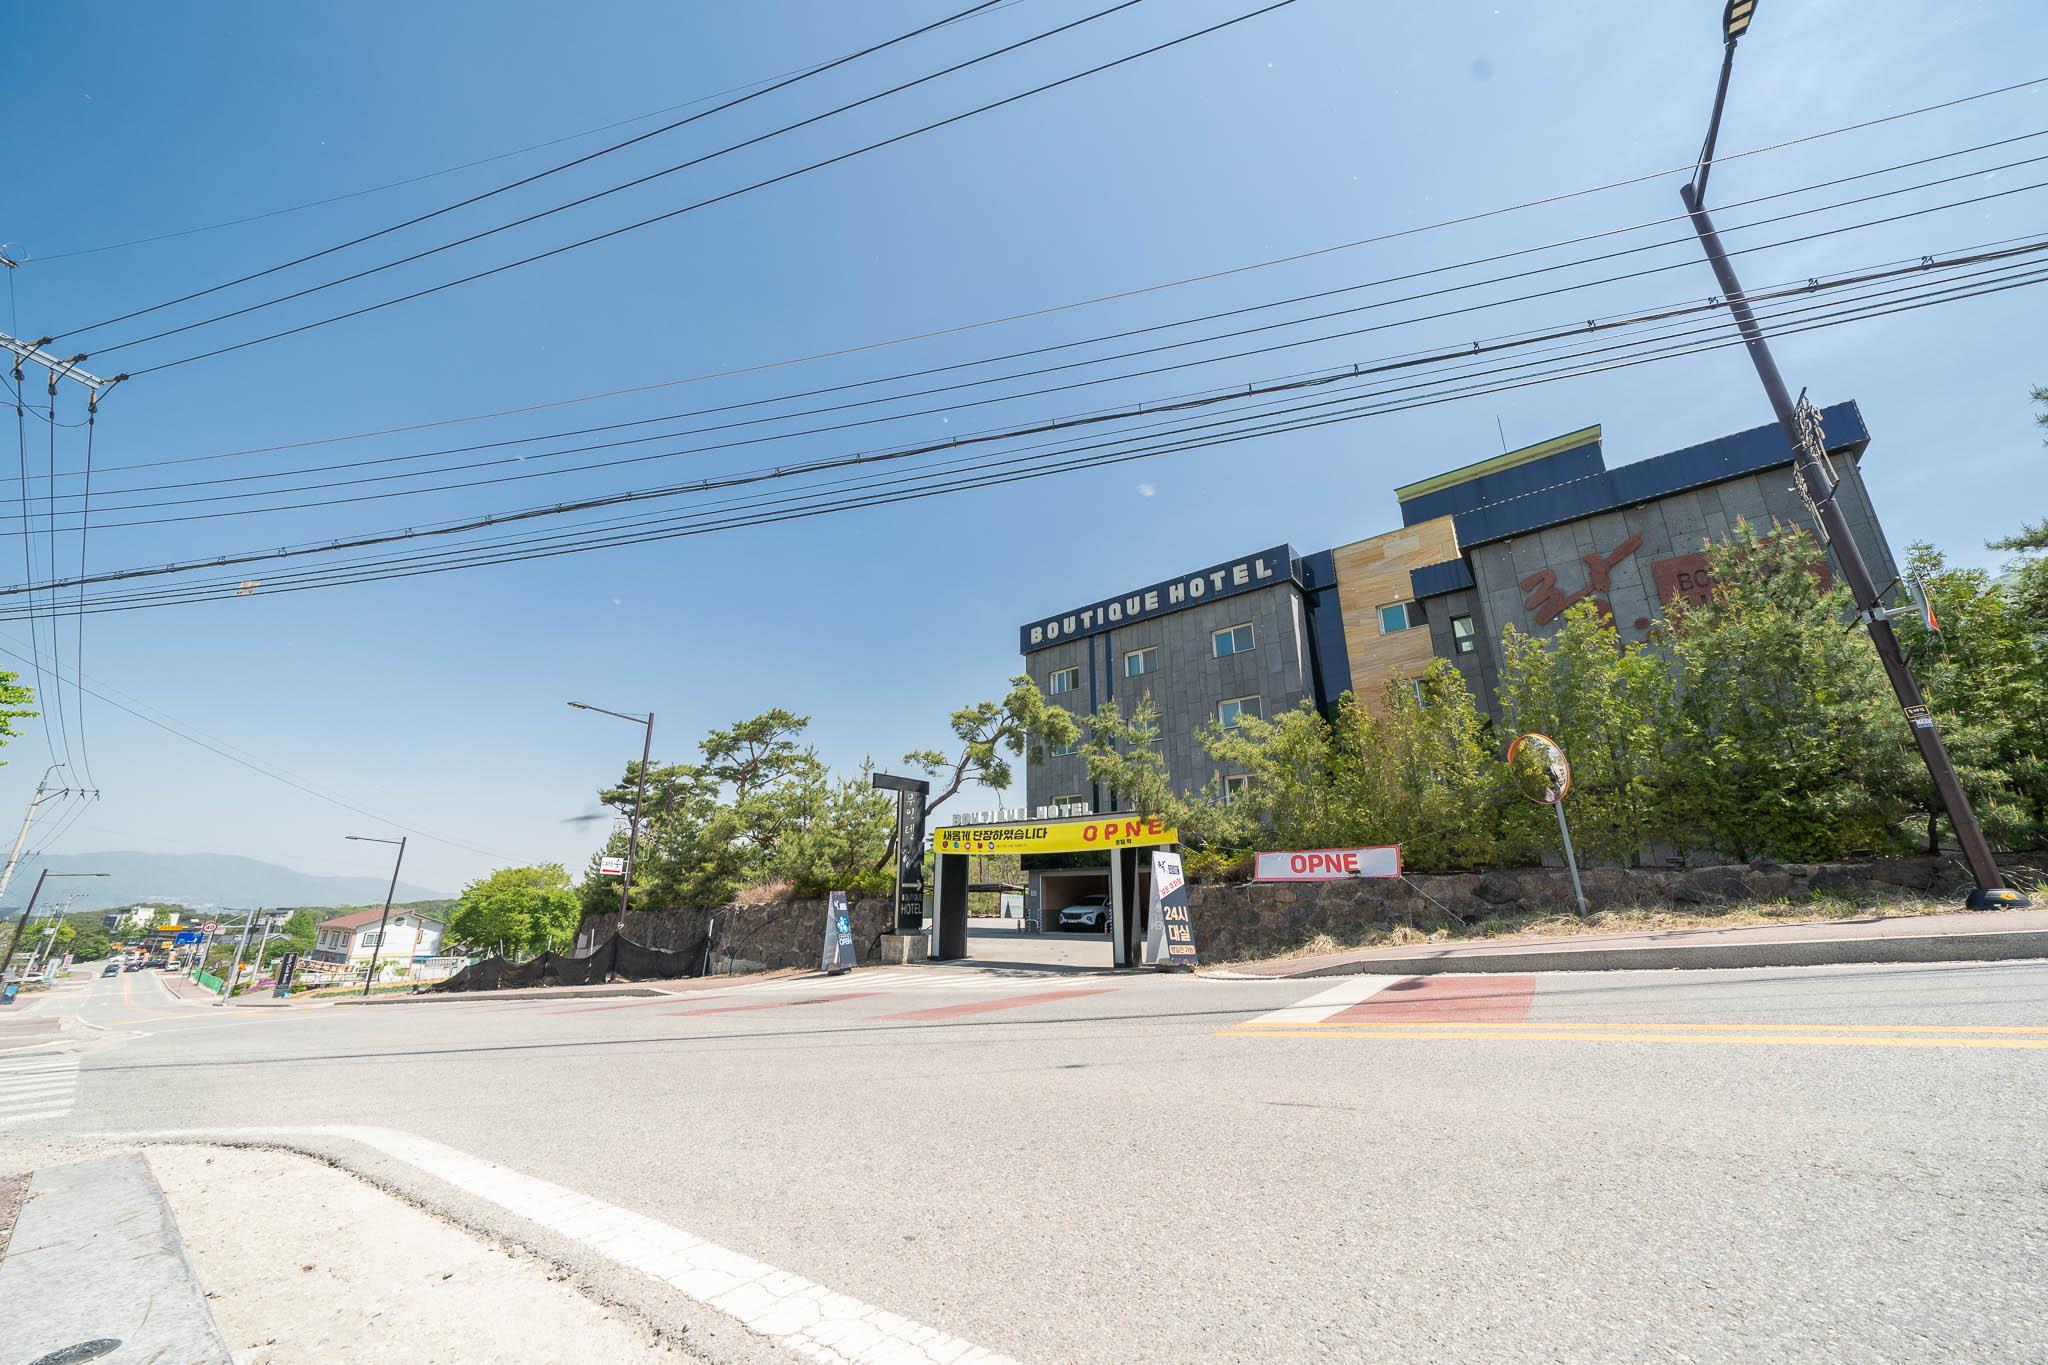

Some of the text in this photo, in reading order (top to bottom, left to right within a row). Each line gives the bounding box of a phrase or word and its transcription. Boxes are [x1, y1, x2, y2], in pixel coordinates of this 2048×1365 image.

[1029, 557, 1273, 646] BOUTIQUE HOTEL
[1036, 802, 1093, 820] HOTEL
[943, 827, 1048, 842] 새롭게 단장하였습니다
[1082, 817, 1163, 843] OPNE
[1290, 853, 1360, 874] OPNE
[900, 903, 922, 915] HOTEL
[1163, 905, 1189, 922] 24시
[1168, 925, 1191, 942] 대실
